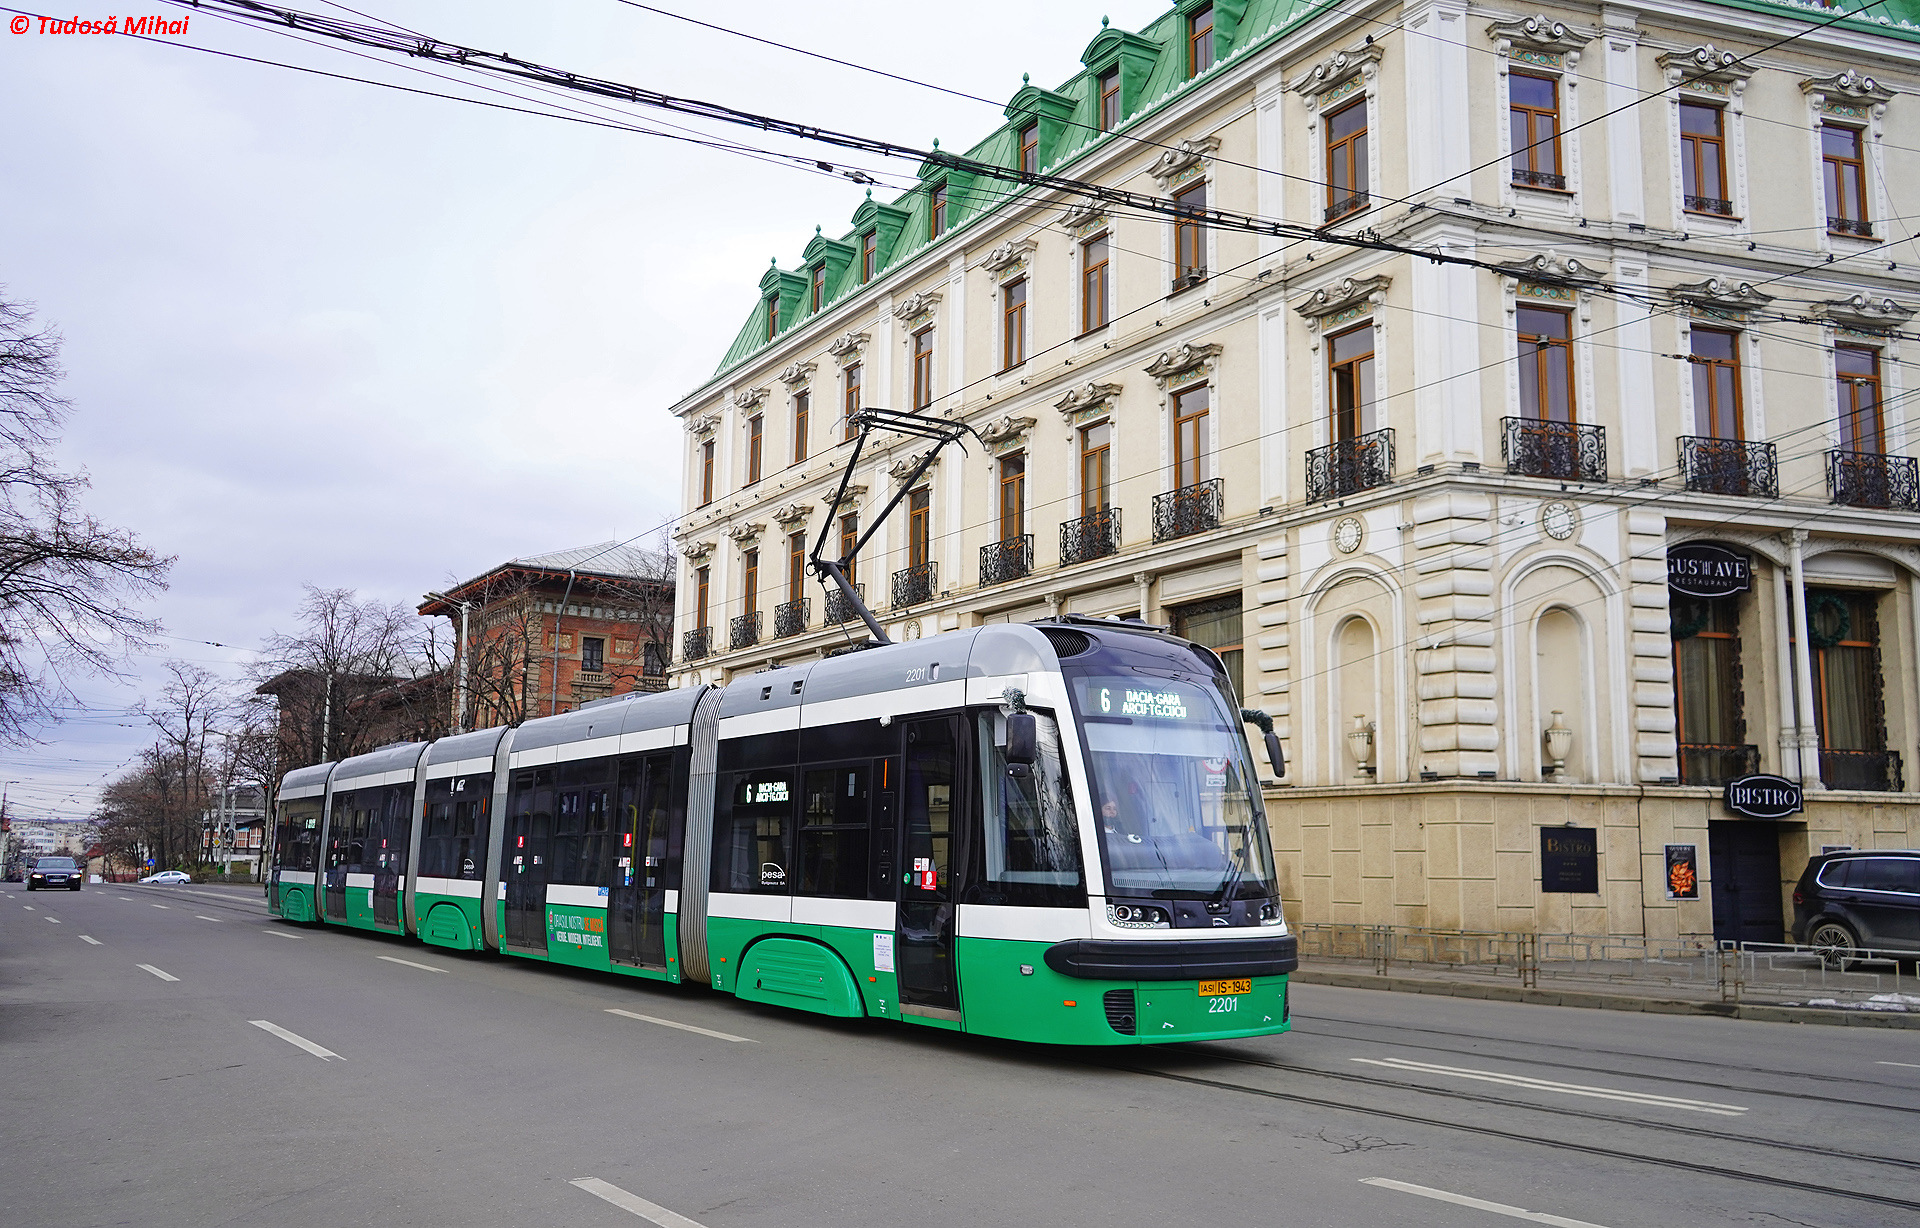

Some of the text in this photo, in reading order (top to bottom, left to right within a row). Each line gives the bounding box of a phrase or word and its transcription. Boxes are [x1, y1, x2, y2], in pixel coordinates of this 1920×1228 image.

[1675, 577, 1733, 587] RESTAURANT
[905, 666, 926, 683] 2201
[1100, 688, 1111, 713] 6
[746, 783, 752, 803] 6
[1736, 787, 1797, 806] BISTRO
[1217, 980, 1251, 994] IS-1943
[1208, 996, 1238, 1013] 2201
